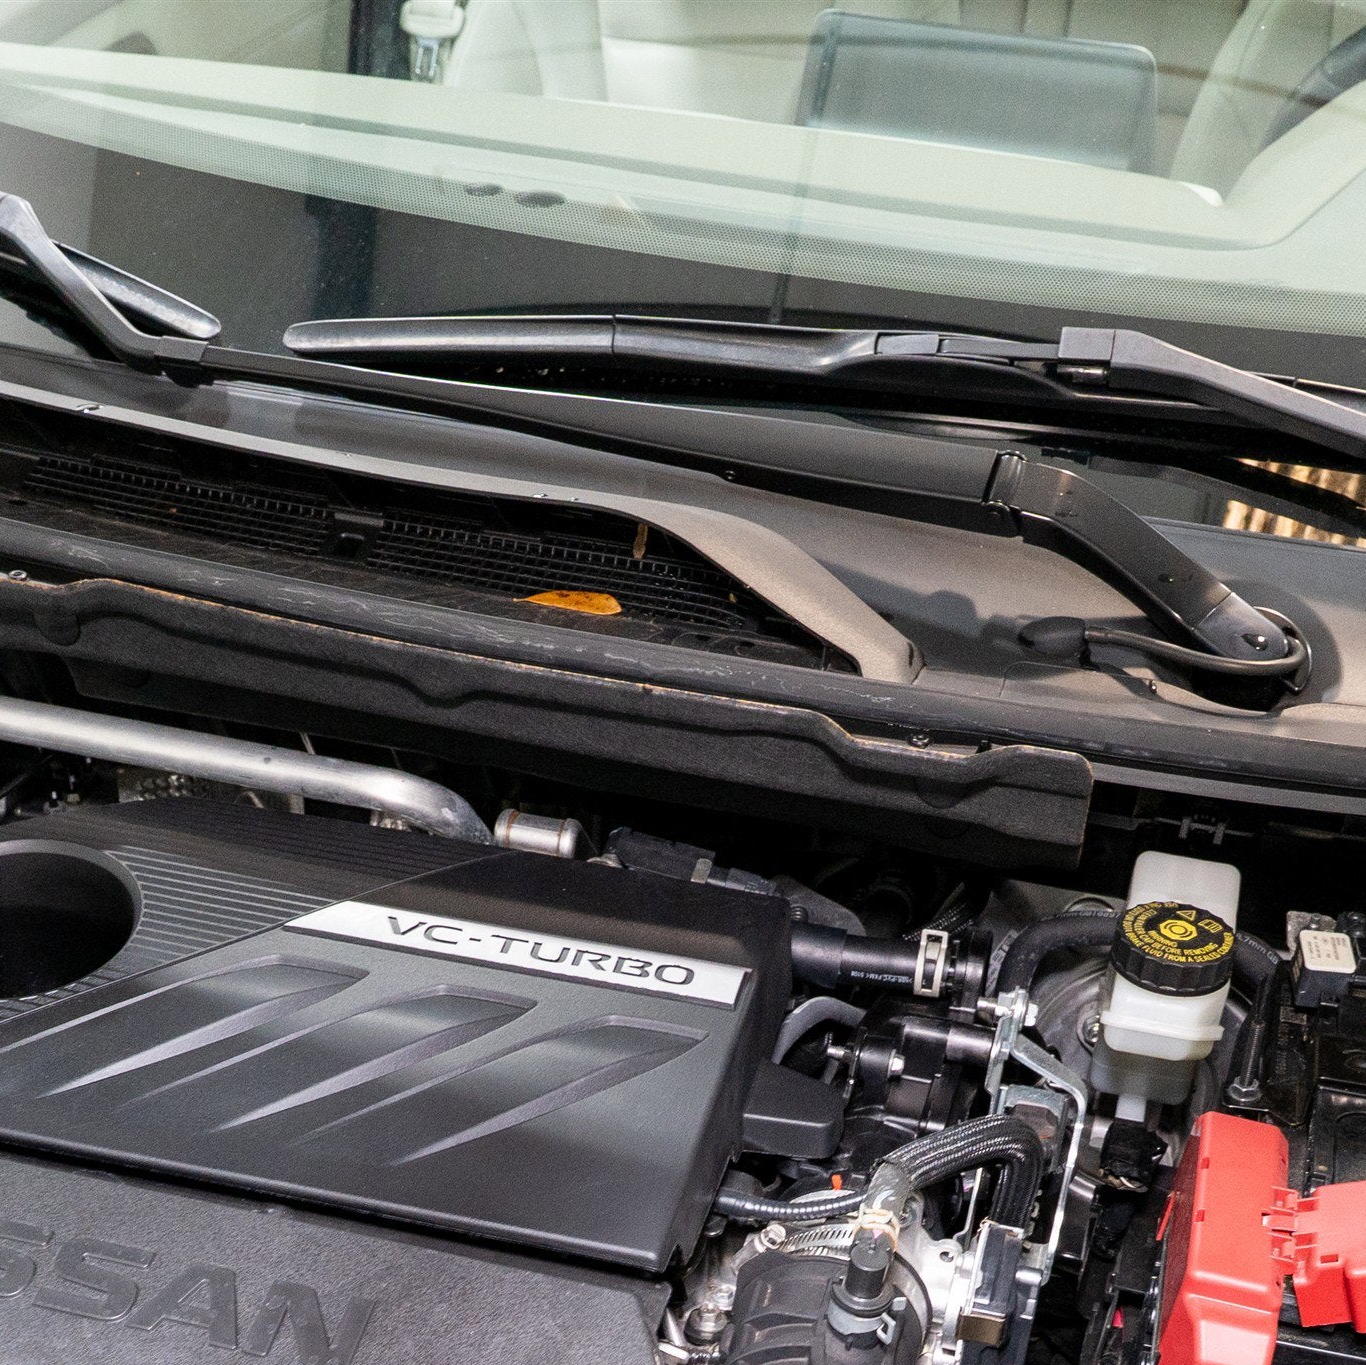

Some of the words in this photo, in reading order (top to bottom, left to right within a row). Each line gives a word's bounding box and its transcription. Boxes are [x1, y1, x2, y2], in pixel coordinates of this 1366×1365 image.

[387, 915, 696, 986] VC-TURBO
[1142, 946, 1163, 958] FLUID
[1163, 953, 1186, 962] FROM
[1151, 941, 1182, 956] BEFORE
